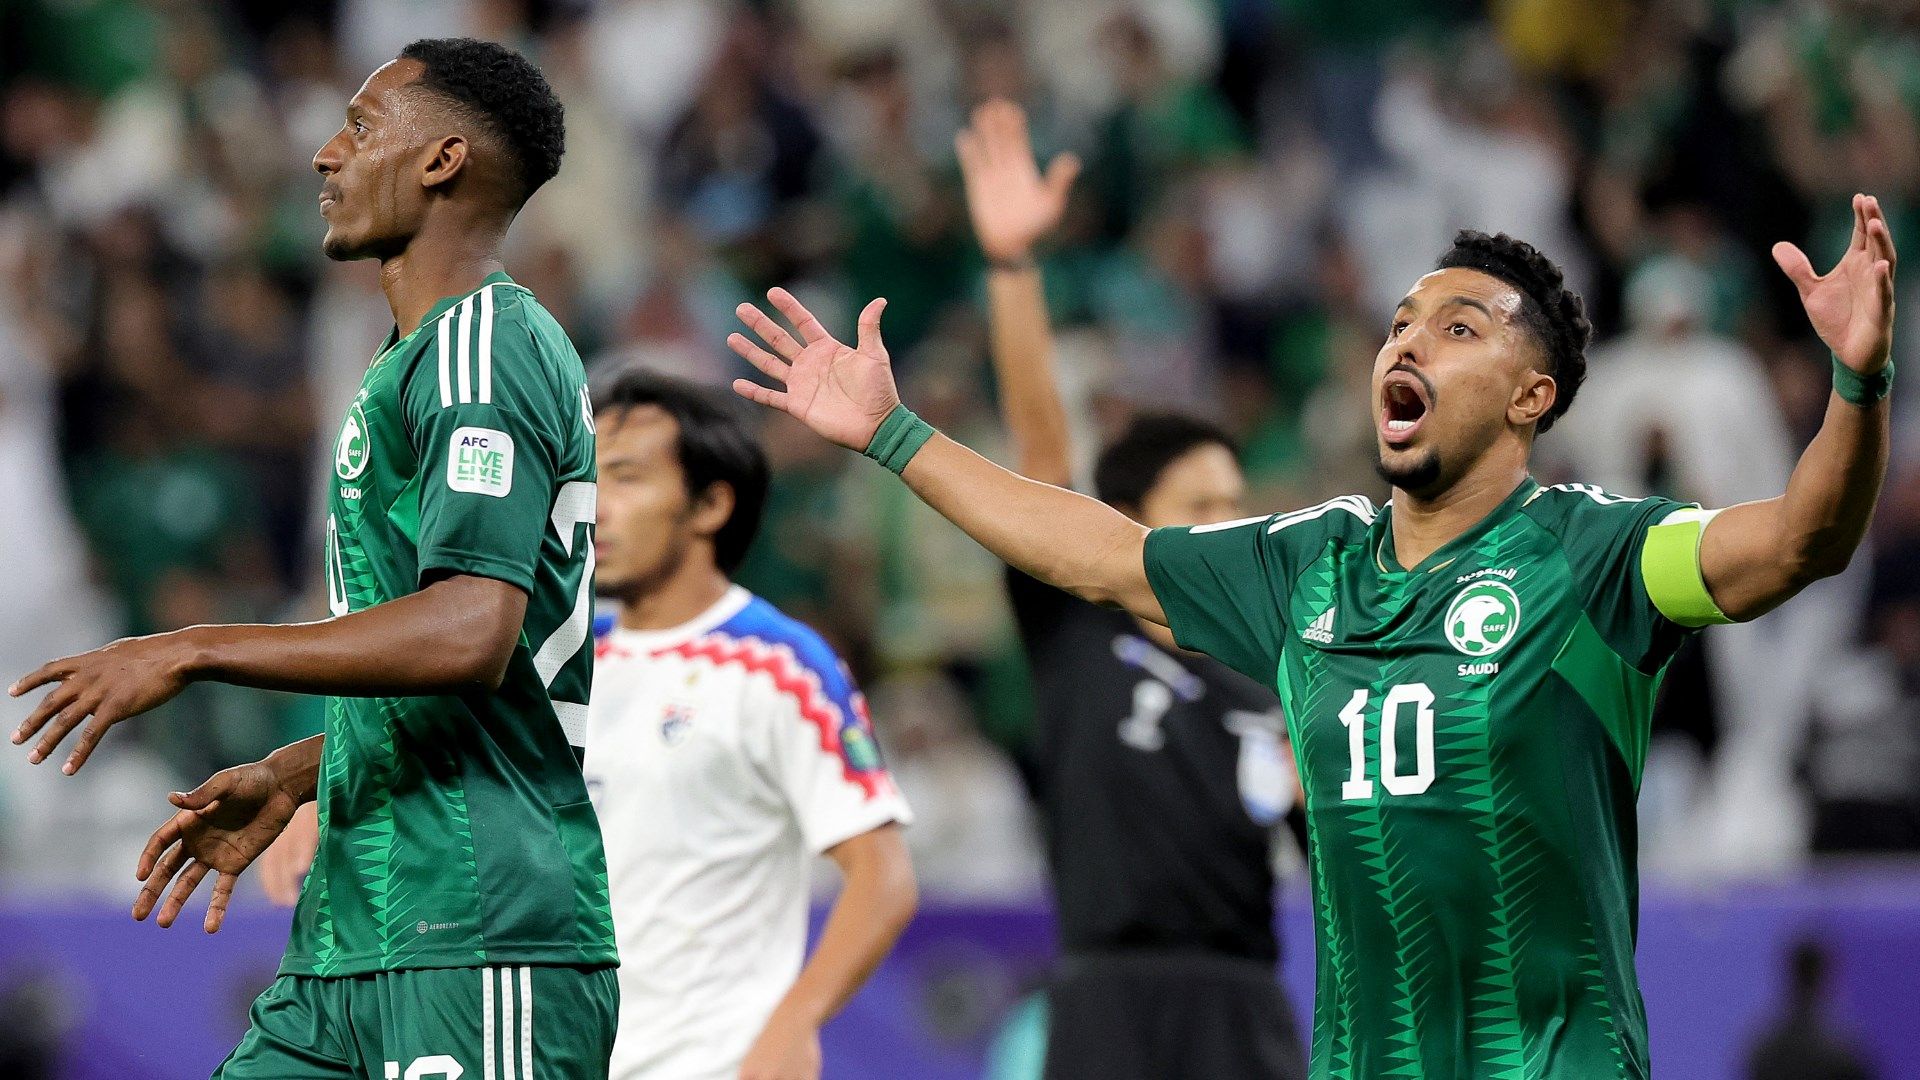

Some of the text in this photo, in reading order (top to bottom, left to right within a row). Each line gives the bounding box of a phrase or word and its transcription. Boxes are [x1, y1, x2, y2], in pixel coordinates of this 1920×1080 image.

[461, 436, 488, 448] AFC
[349, 449, 362, 457] SAFF
[458, 448, 504, 469] LIVE
[1302, 628, 1335, 644] adidas
[1483, 624, 1506, 633] SAFF
[1457, 662, 1500, 677] SAUDI
[1337, 682, 1436, 801] 10
